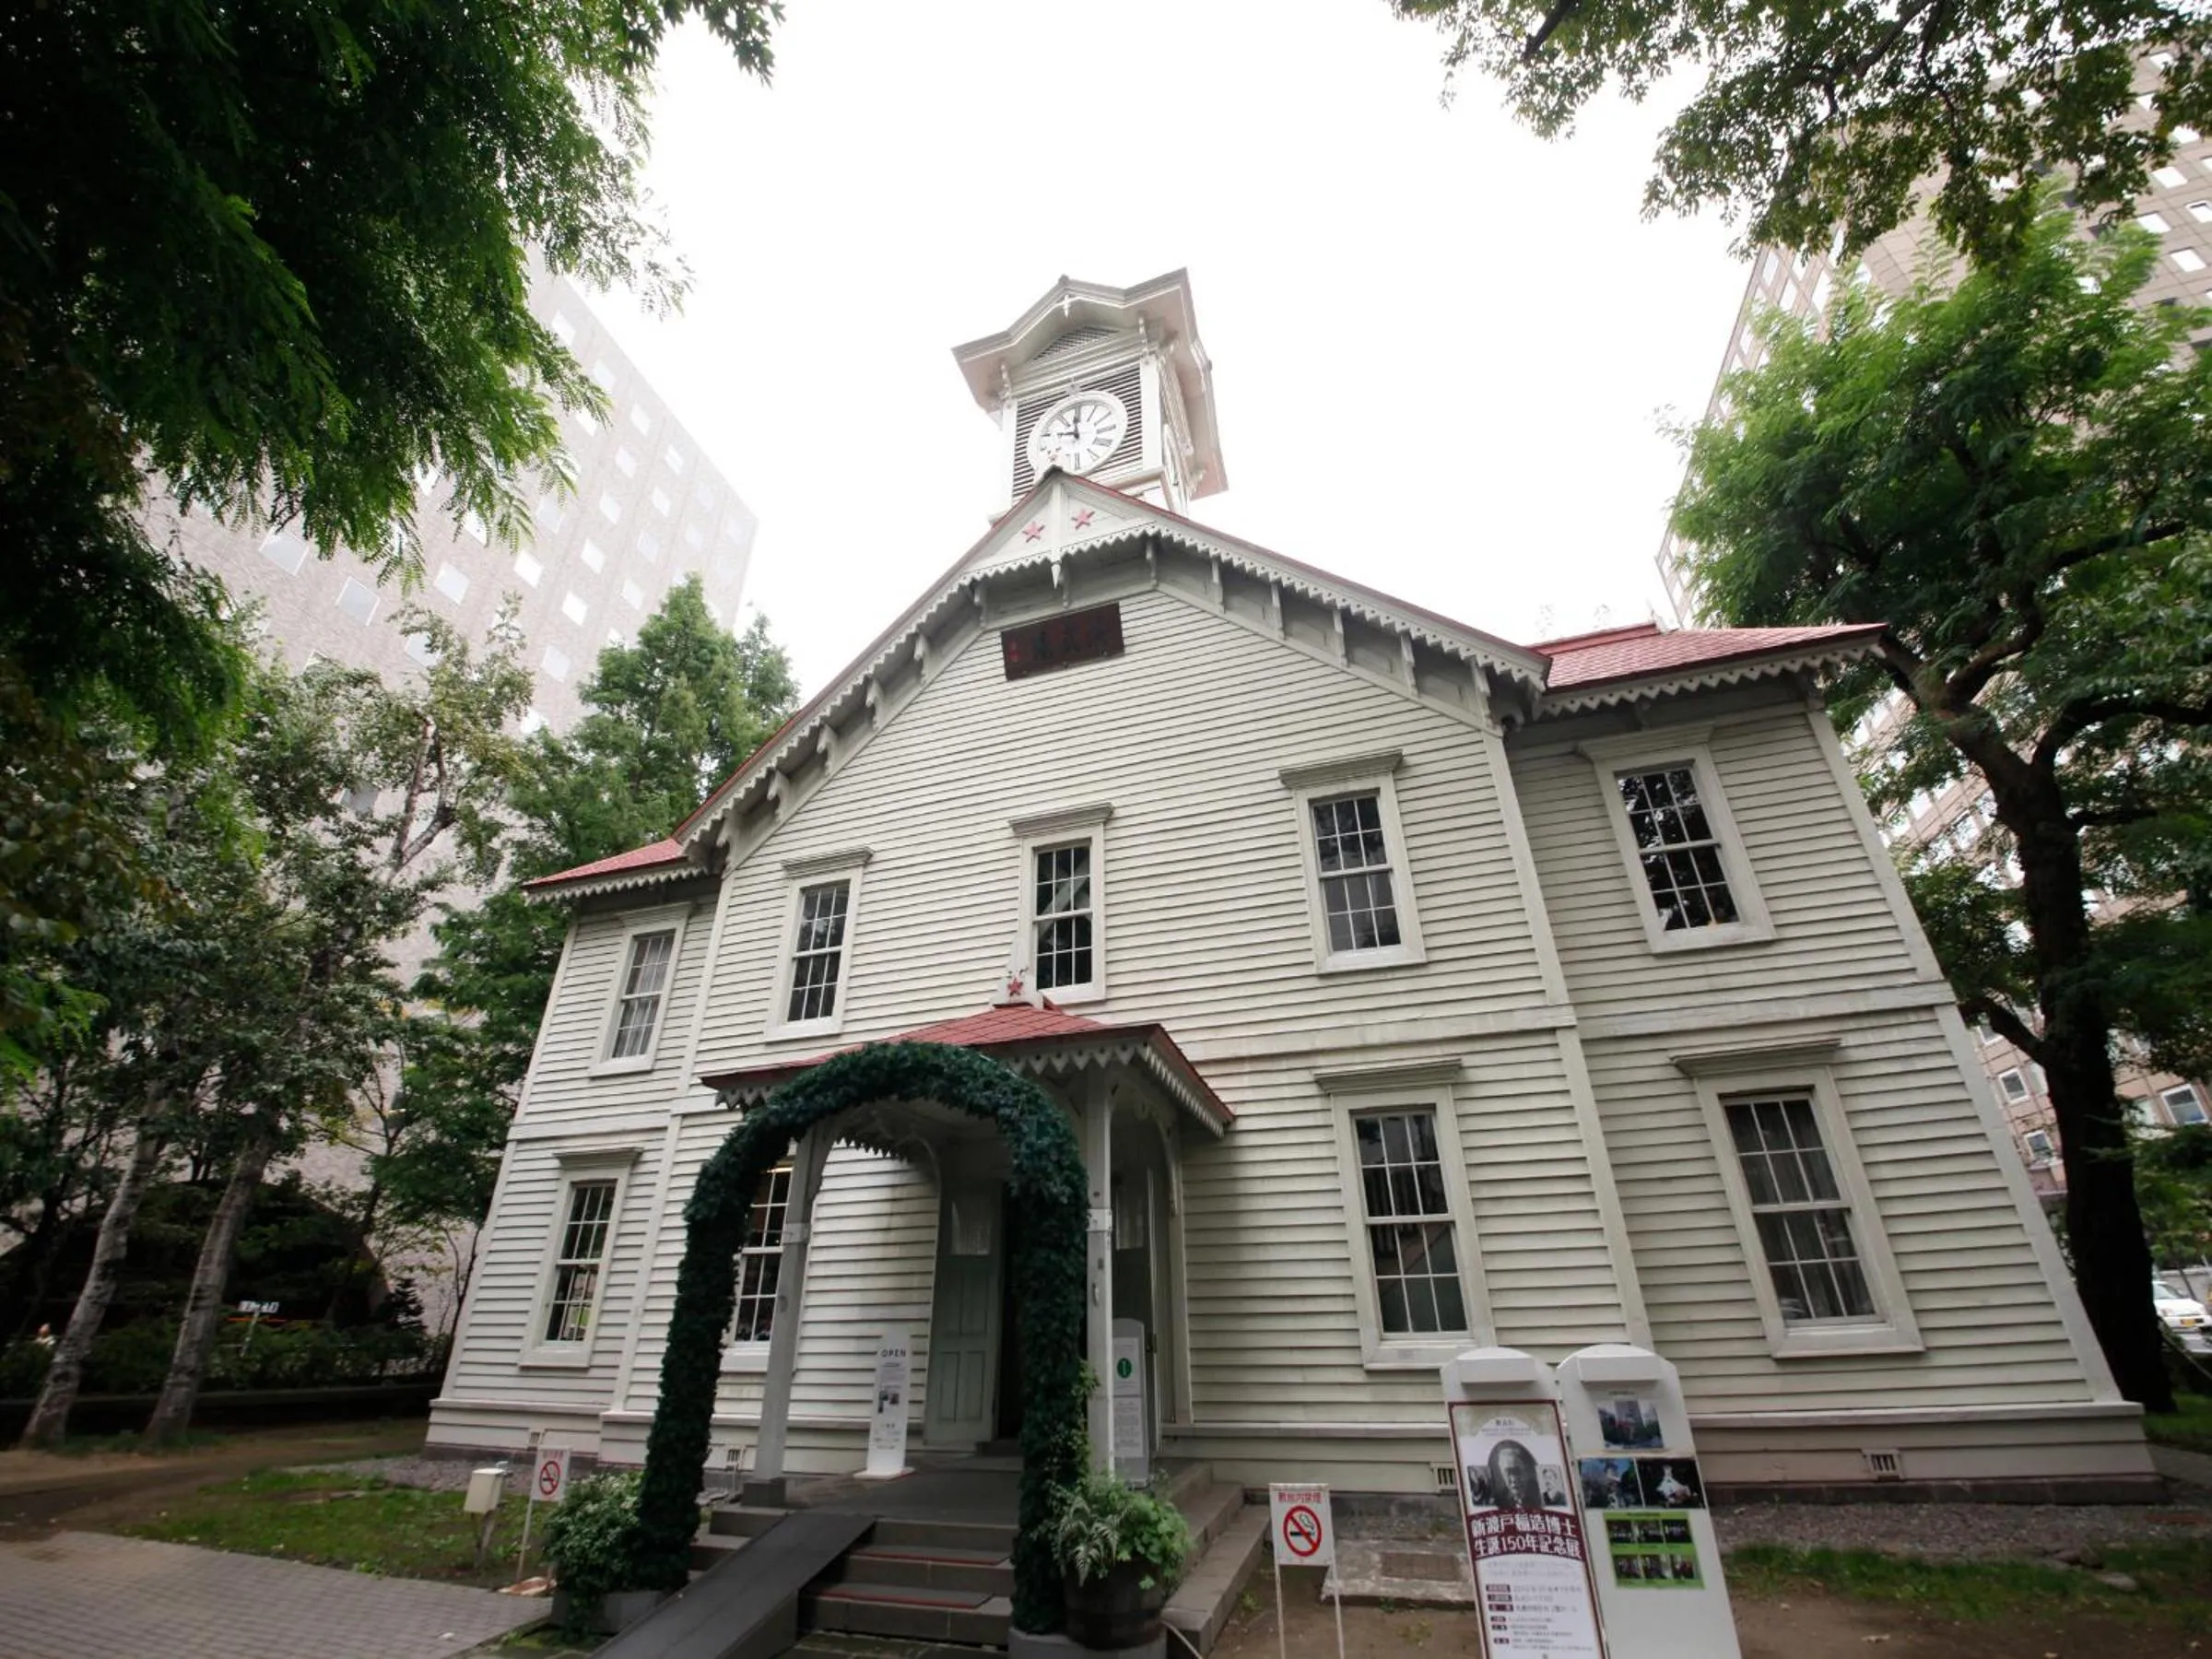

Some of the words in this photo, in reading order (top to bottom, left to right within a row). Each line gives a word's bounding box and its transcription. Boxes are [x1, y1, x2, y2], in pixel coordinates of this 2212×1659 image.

[880, 1348, 906, 1358] OPEN
[1475, 1534, 1583, 1559] 生誕150年記念展
